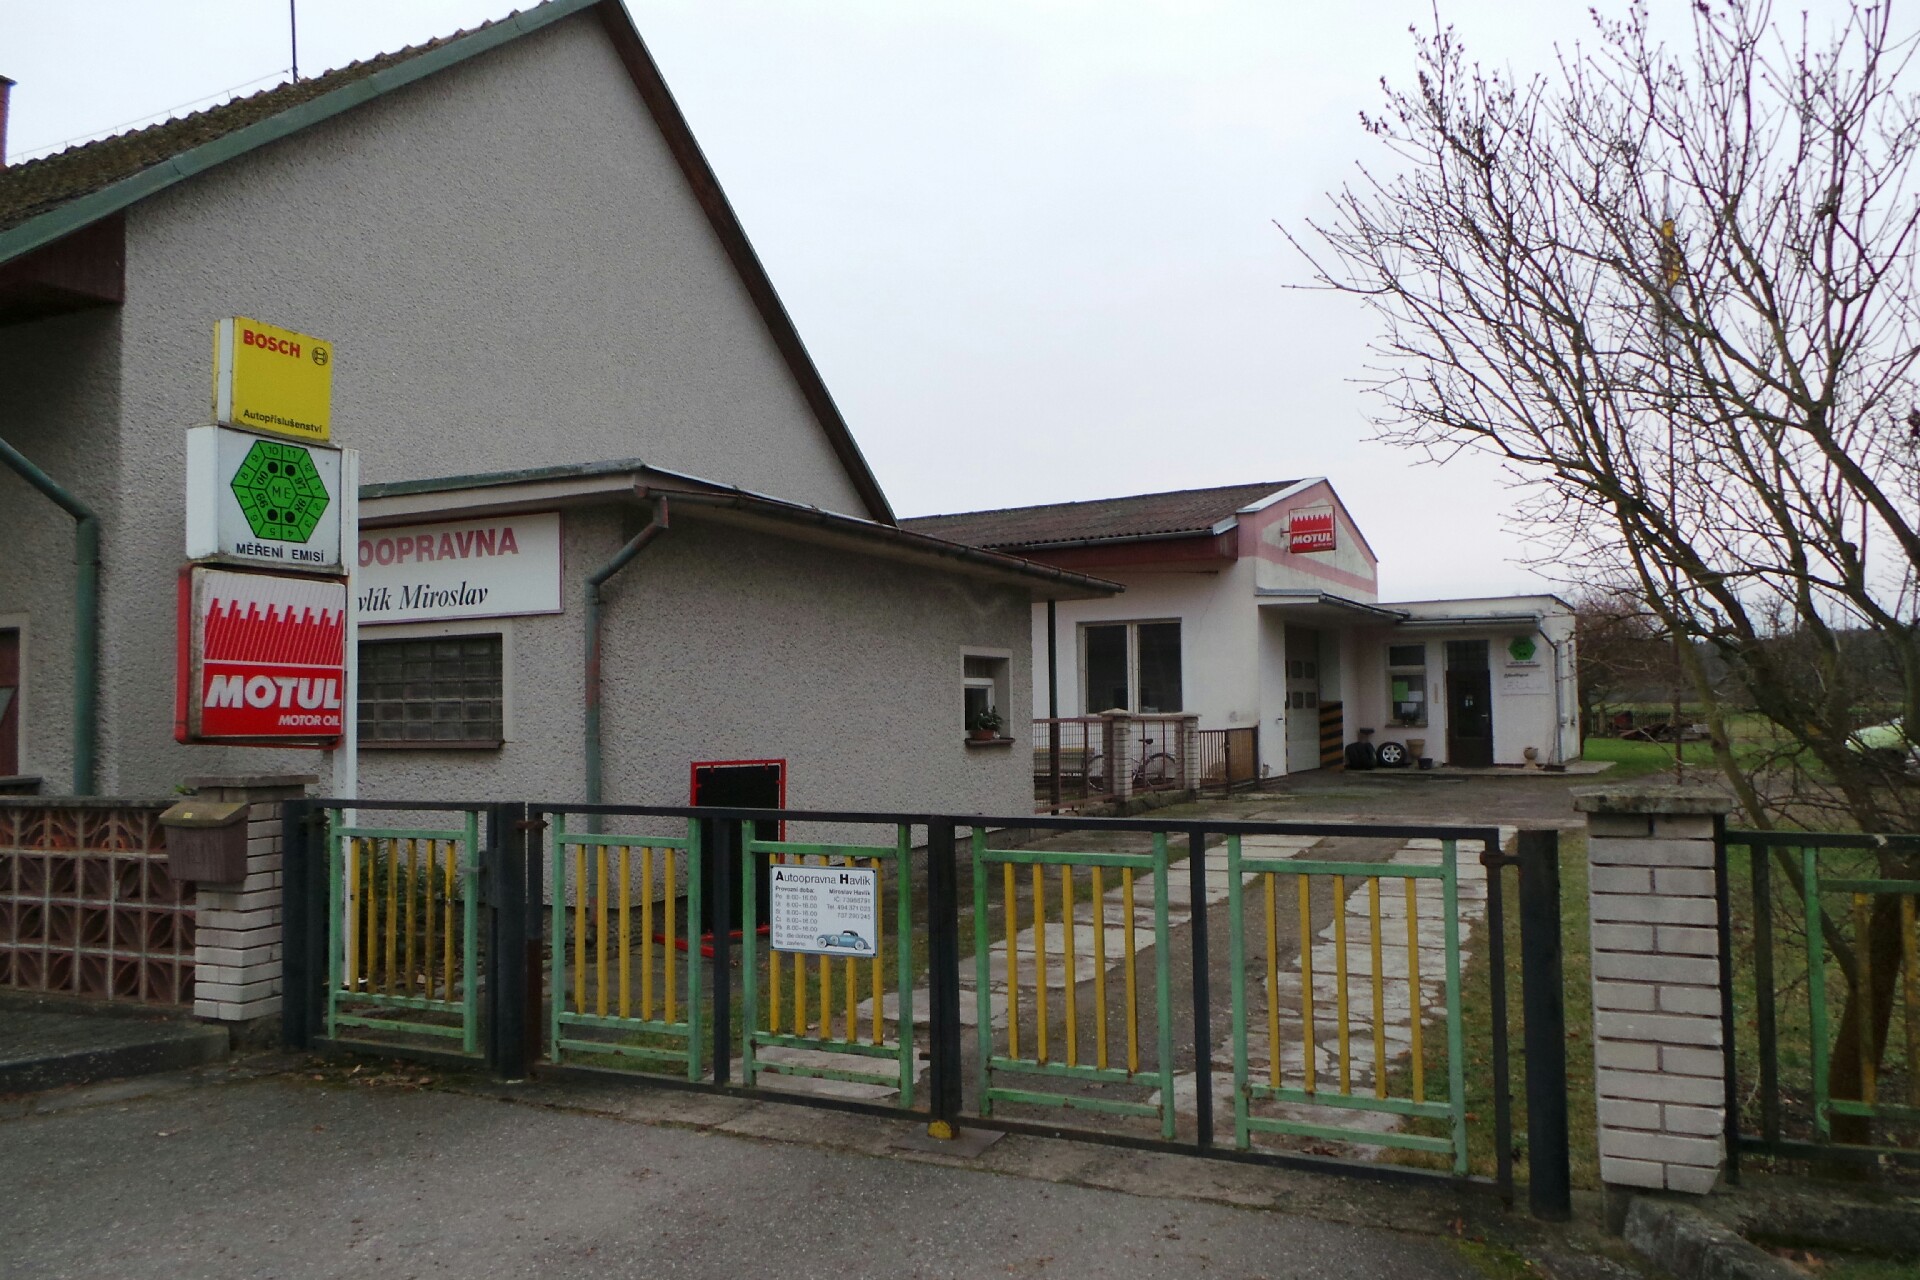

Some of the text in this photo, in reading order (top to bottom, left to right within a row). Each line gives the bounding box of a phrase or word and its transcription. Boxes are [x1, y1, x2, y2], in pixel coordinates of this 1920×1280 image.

[243, 330, 301, 358] BOSCH
[243, 409, 322, 433] Autopříslušenství
[268, 446, 279, 456] 10
[287, 450, 296, 458] 11
[1292, 533, 1332, 544] MOTUL
[236, 543, 283, 559] MĚŘENÍ
[399, 581, 488, 610] Miroslav
[204, 675, 341, 709] MOTUL
[278, 715, 340, 726] MOTOR OIL
[776, 871, 871, 886] Autoopravna Havlík
